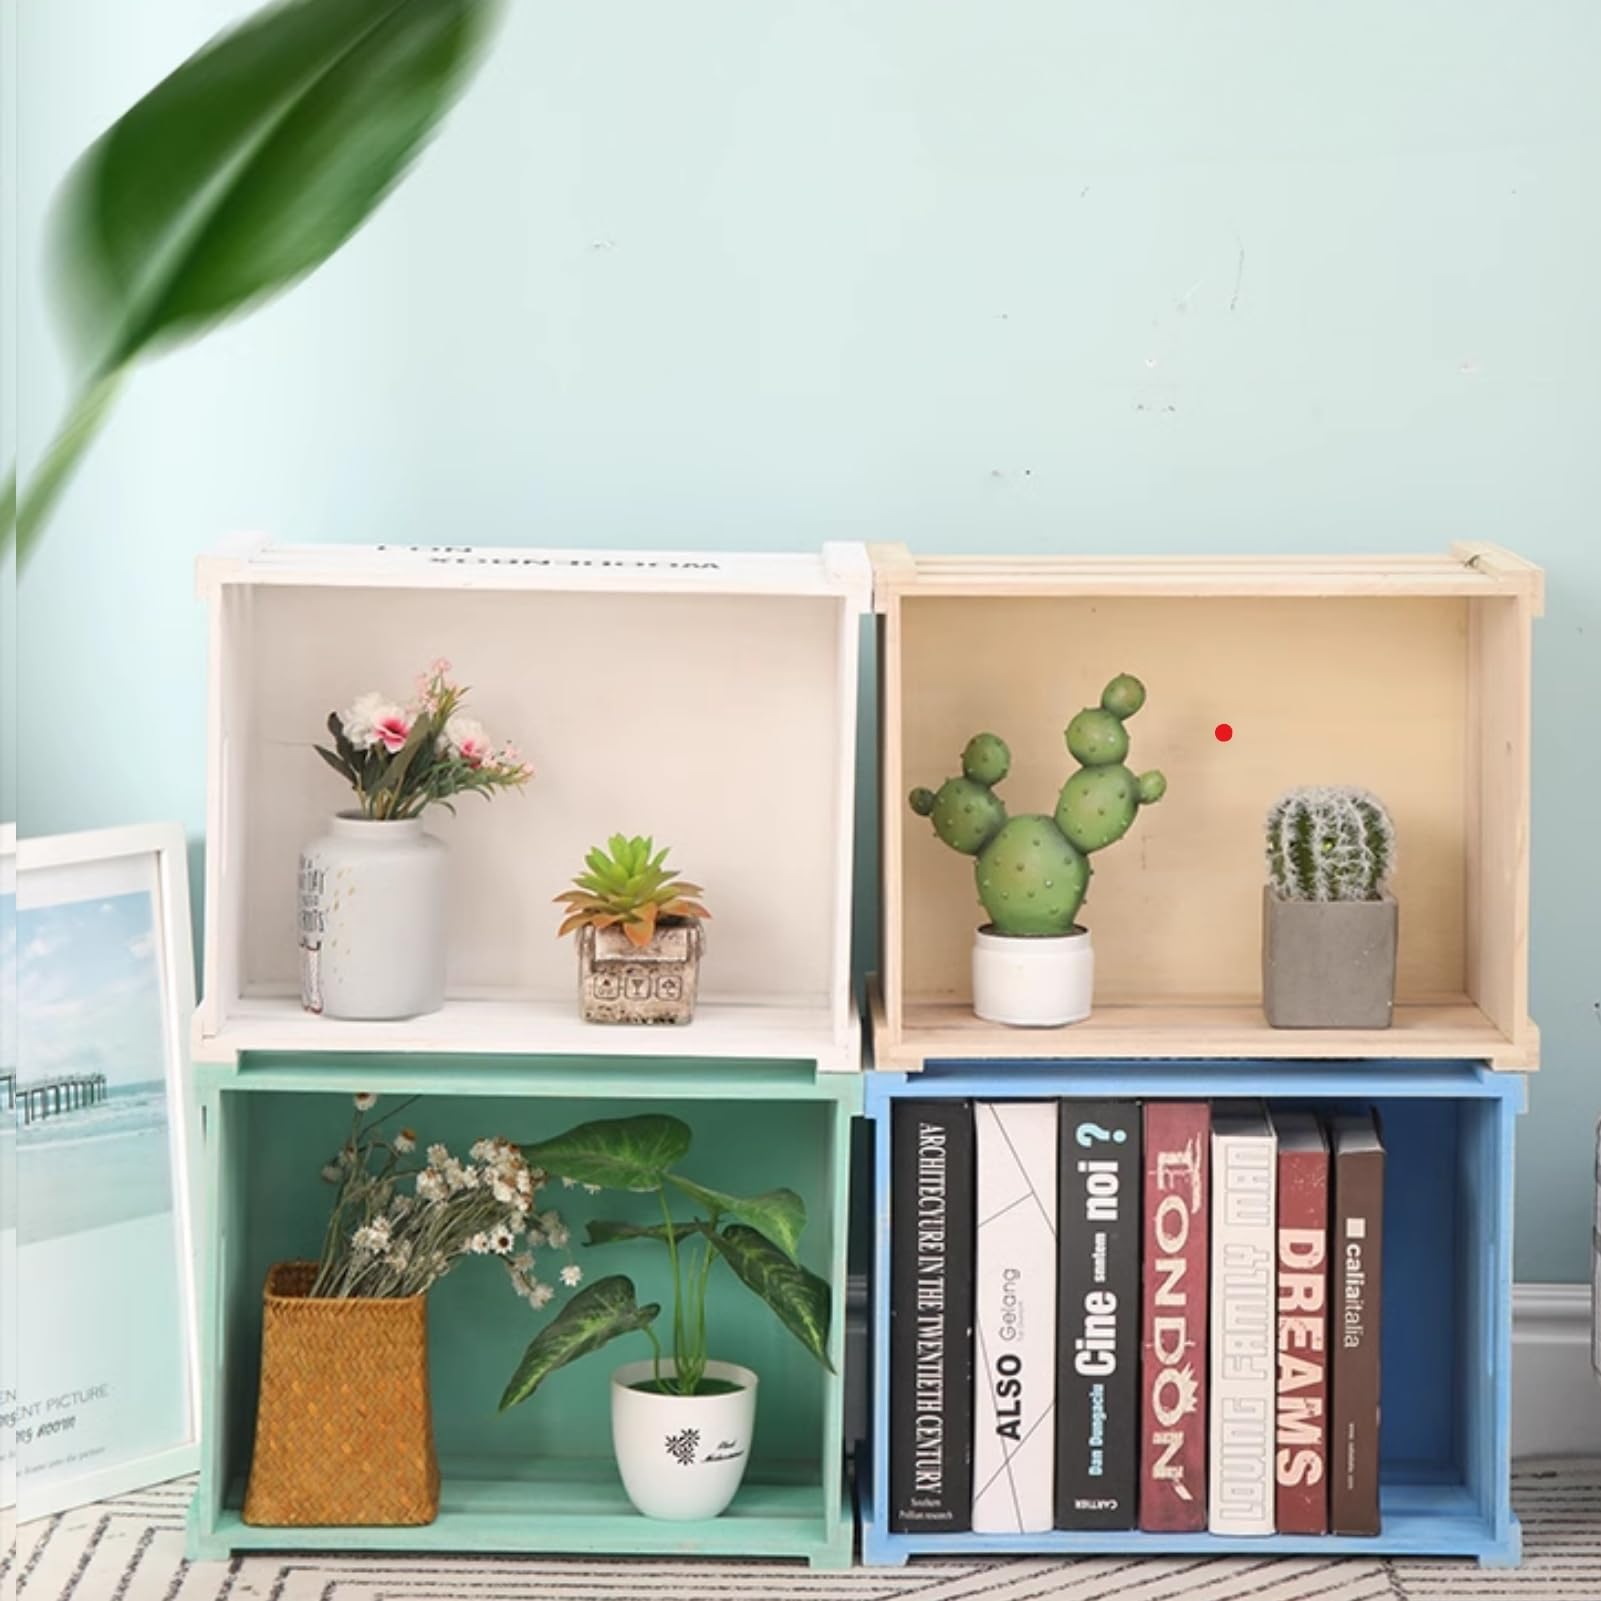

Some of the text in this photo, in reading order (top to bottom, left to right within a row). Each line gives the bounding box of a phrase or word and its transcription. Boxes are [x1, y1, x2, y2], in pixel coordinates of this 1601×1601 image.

[1078, 1160, 1119, 1221] noi
[1223, 1143, 1271, 1227] MAN
[917, 1255, 946, 1274] IN
[917, 1276, 946, 1311] THE
[1343, 1242, 1366, 1348] caliaitalia
[996, 1268, 1022, 1441] ALSO Gelang
[1074, 1291, 1117, 1377] Cine
[1151, 1132, 1202, 1500] LONDON
[1222, 1243, 1270, 1381] FAMILY
[46, 1383, 109, 1413] PICTURE
[916, 1313, 945, 1411] TWENTIETH
[1275, 1228, 1326, 1488] DREAMS
[915, 1414, 944, 1494] CENTURY
